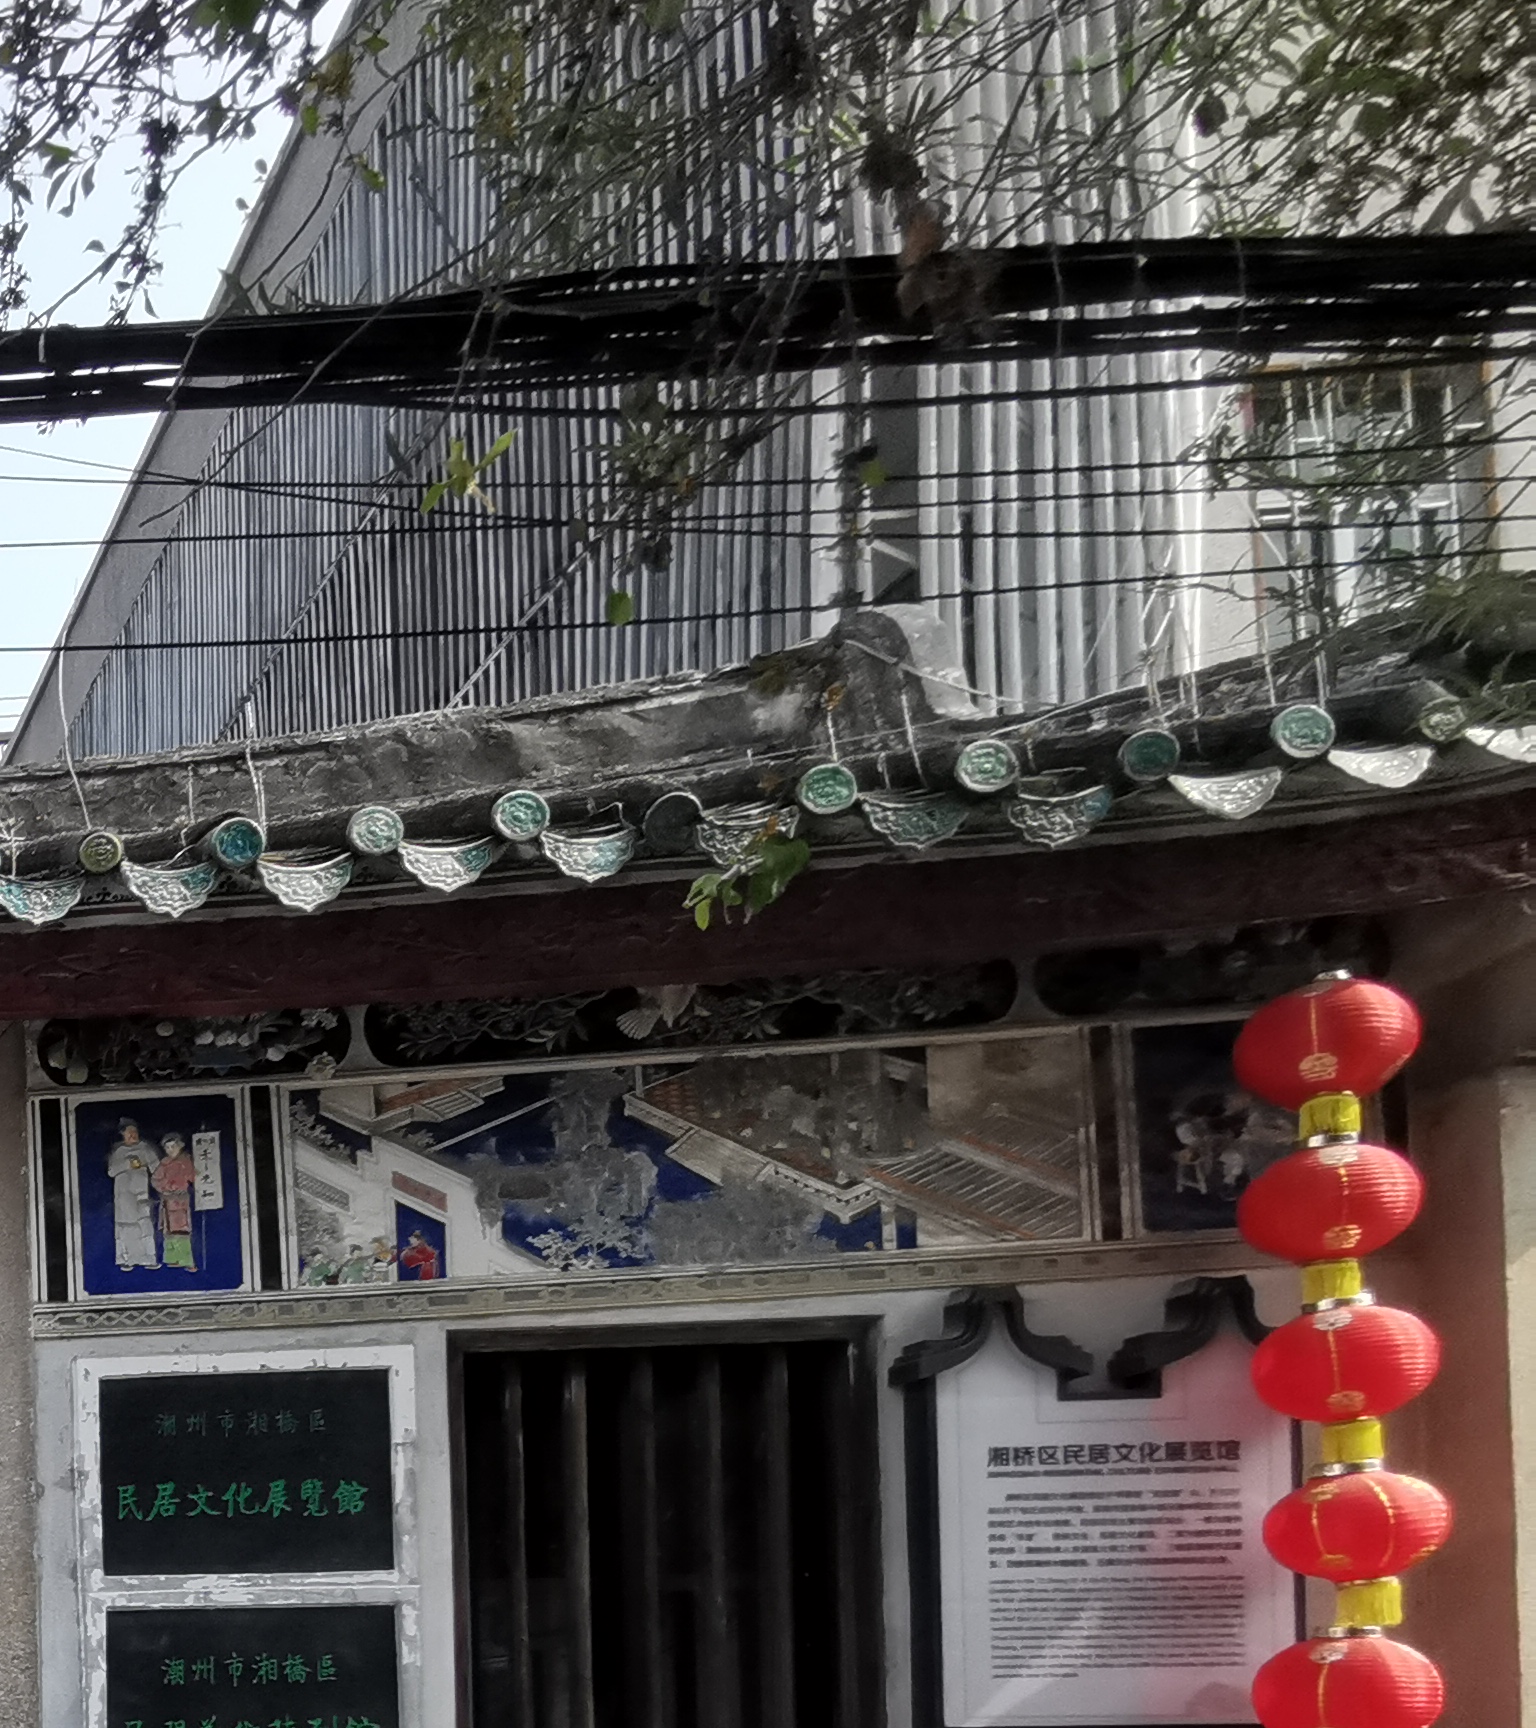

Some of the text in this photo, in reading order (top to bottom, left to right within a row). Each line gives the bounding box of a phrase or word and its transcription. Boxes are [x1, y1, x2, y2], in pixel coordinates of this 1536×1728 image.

[986, 1439, 1241, 1468] 湘桥区民居文化展览馆
[116, 1478, 369, 1522] 民居文化展覽館
[159, 1651, 339, 1687] 潮州市湘橋區
